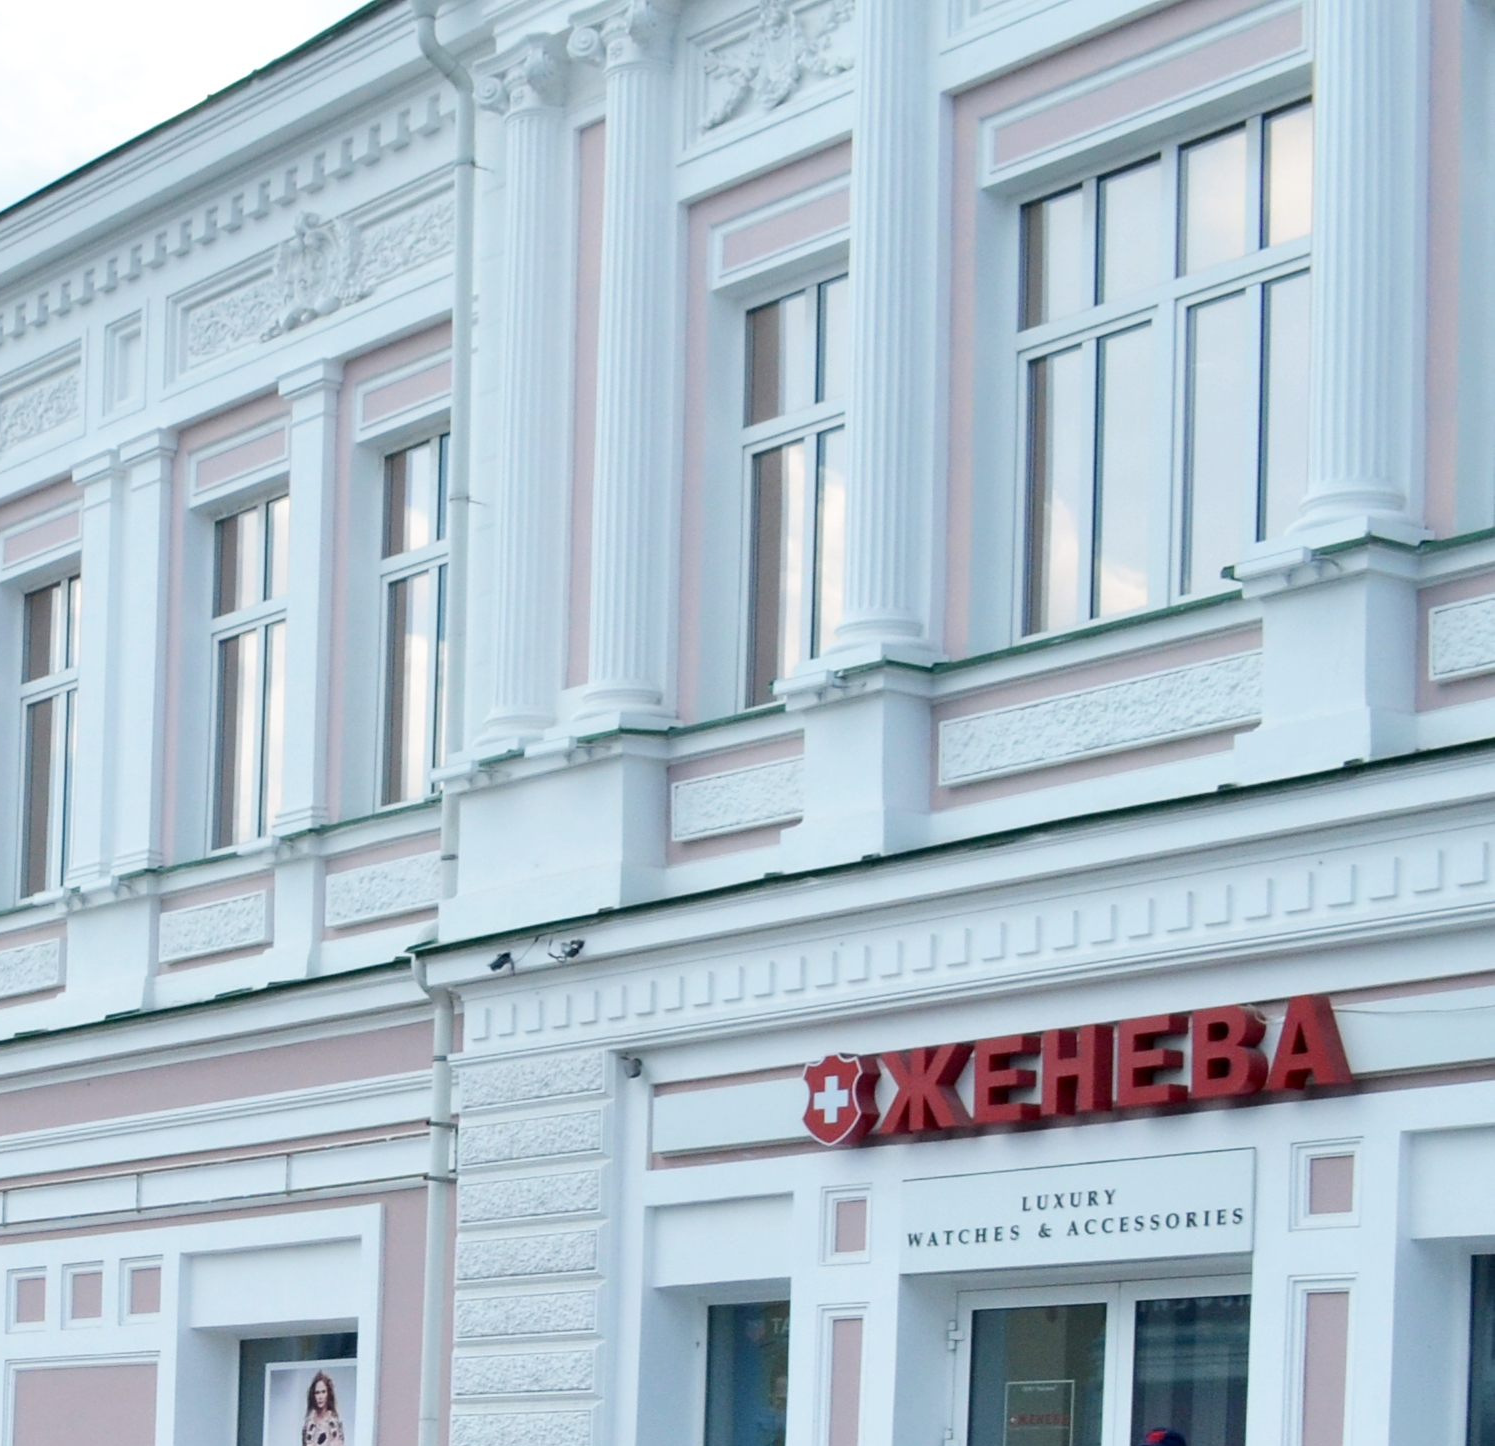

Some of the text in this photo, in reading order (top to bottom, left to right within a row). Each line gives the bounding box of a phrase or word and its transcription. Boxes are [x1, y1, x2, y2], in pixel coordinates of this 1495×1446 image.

[878, 994, 1353, 1135] ЖЕНЕВА
[1021, 1188, 1117, 1213] LUXURY
[906, 1207, 1245, 1249] WATCHES & ACCESSORIES
